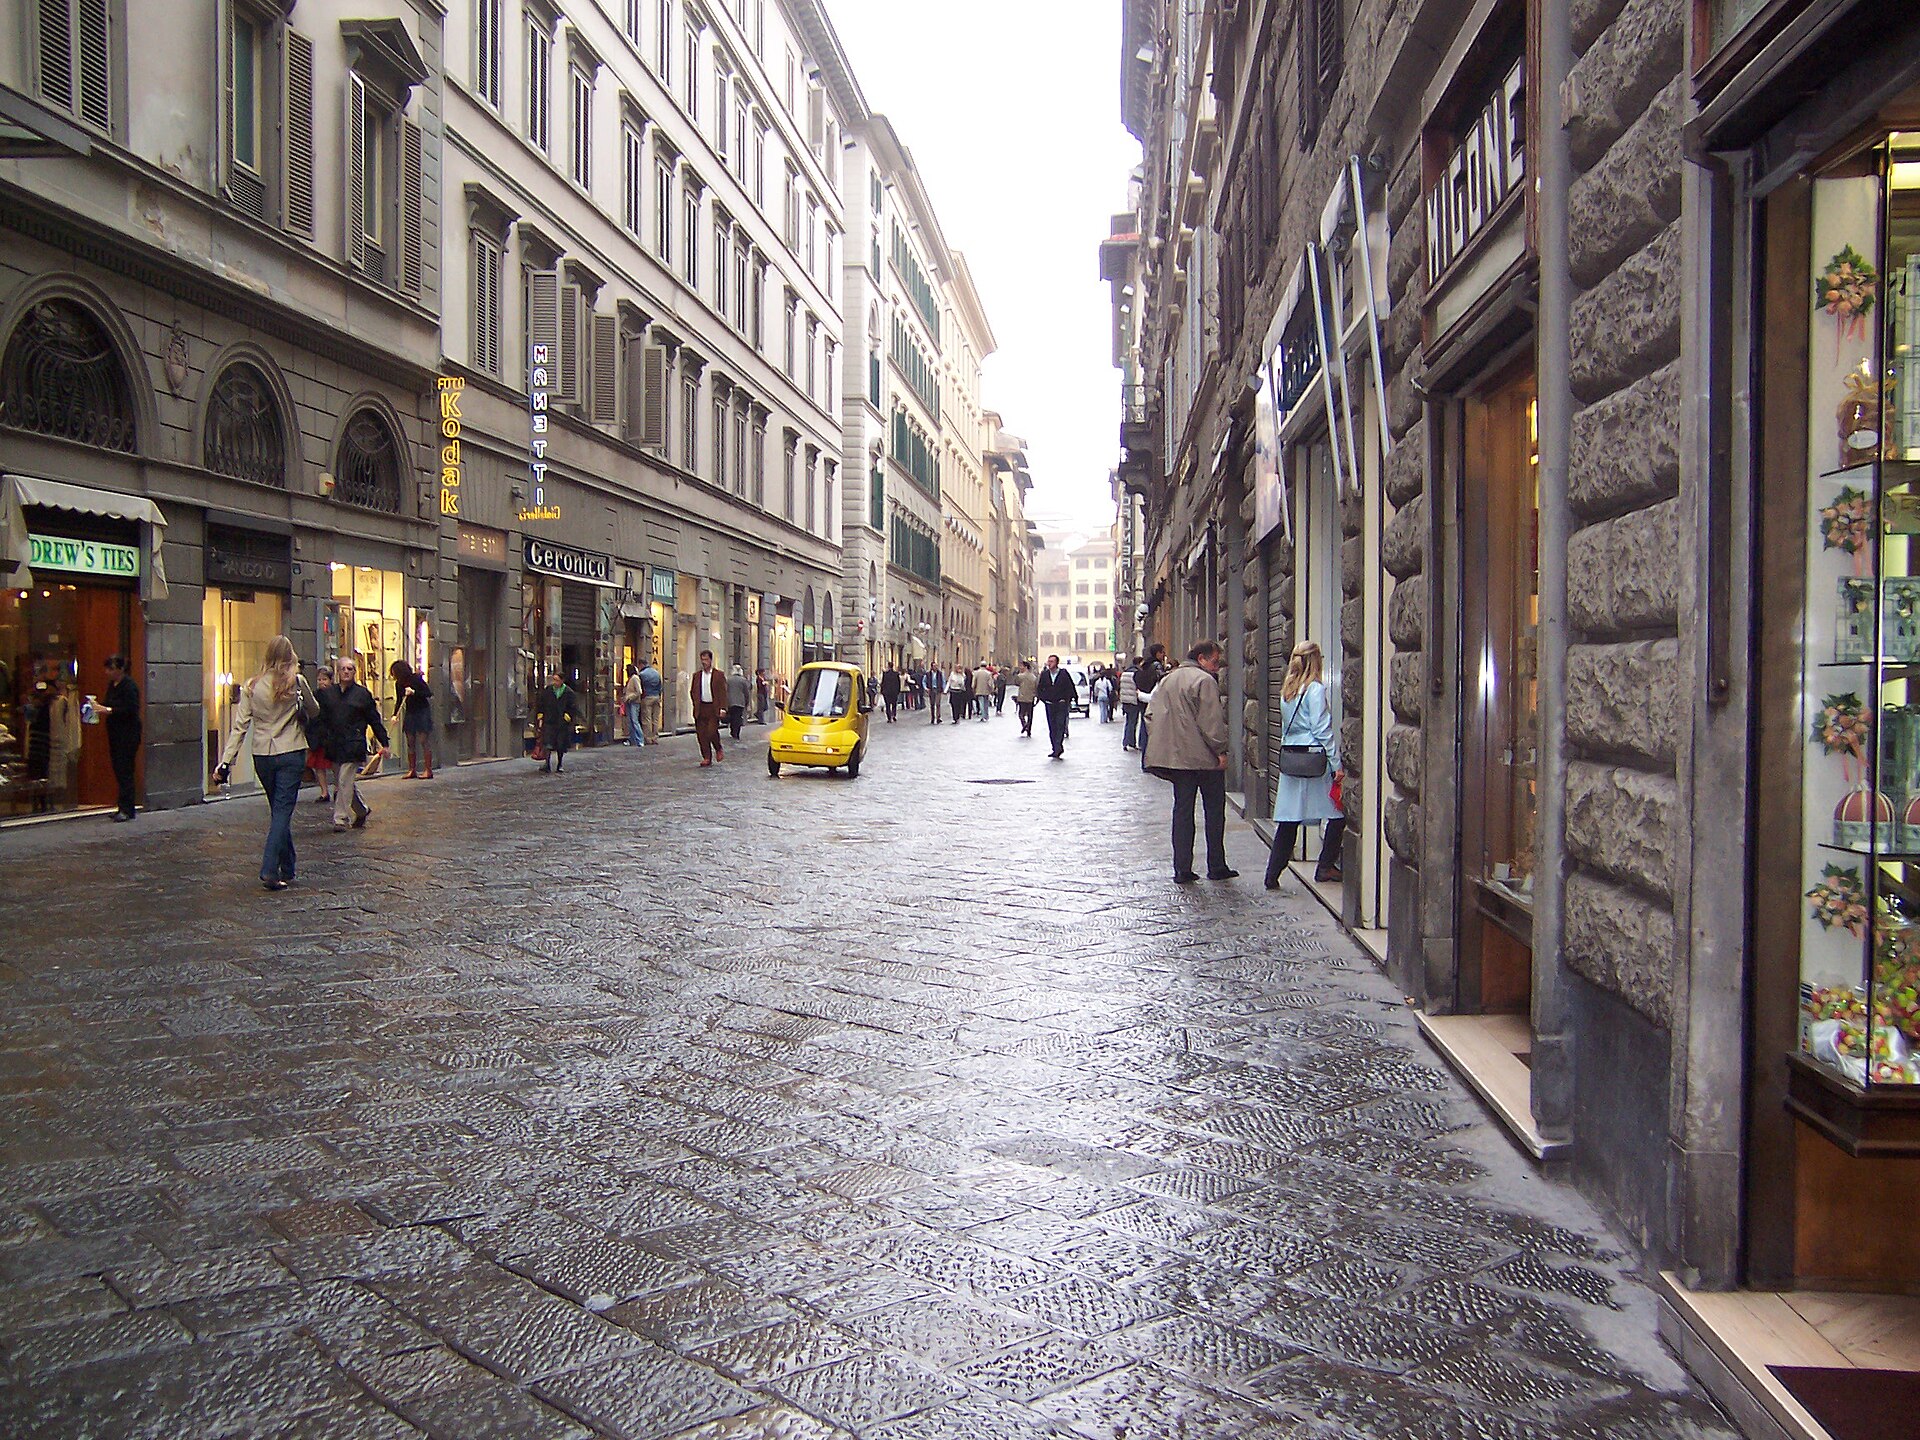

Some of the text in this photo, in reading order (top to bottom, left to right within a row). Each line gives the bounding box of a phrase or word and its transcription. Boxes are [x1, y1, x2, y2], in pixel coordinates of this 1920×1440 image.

[1426, 56, 1524, 287] MIGONE
[437, 376, 465, 390] FOTO
[440, 391, 462, 514] Kodak
[101, 547, 135, 572] TIES
